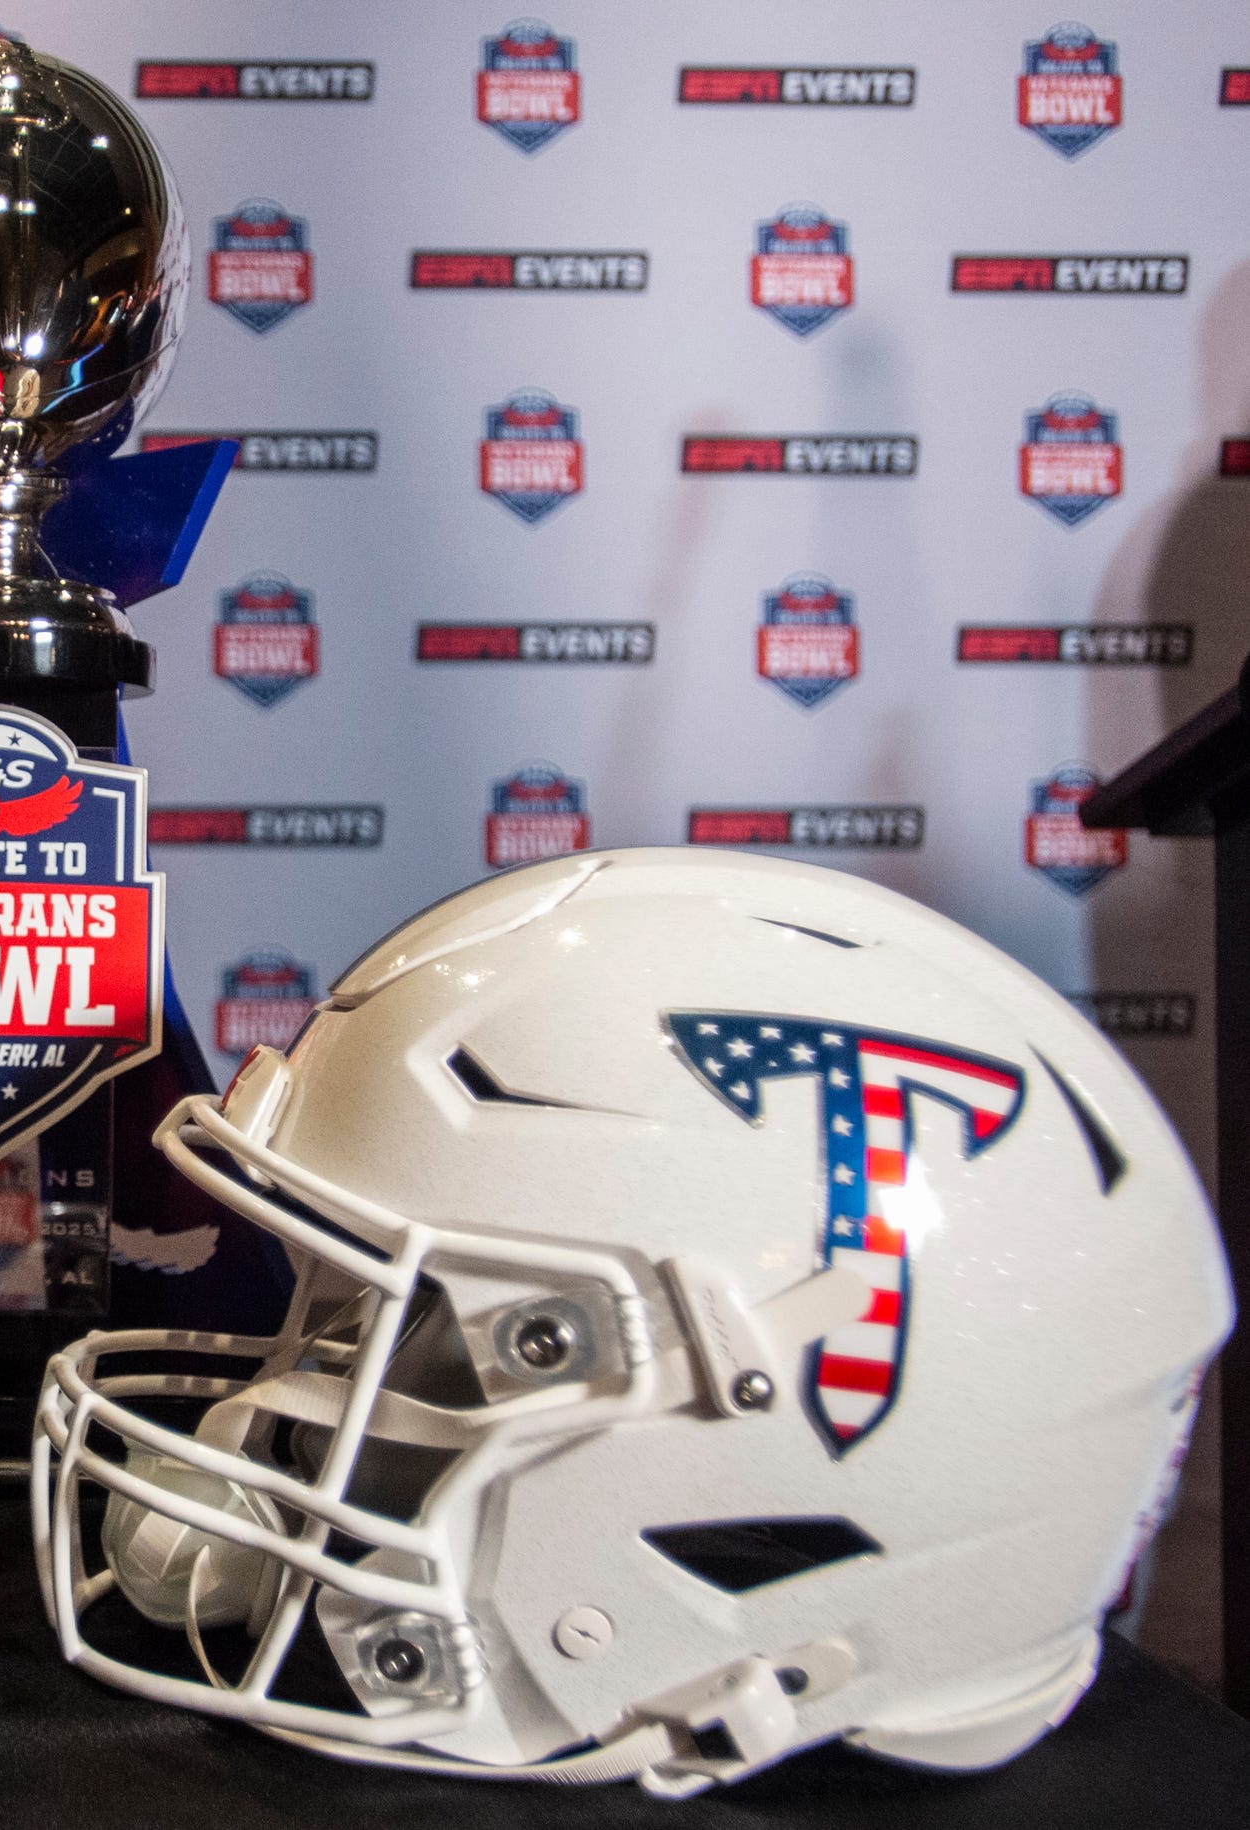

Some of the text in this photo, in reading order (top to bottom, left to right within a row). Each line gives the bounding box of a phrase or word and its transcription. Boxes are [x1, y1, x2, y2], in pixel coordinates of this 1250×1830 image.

[240, 65, 371, 97] EVENTS
[781, 69, 912, 101] EVENTS
[1029, 92, 1113, 122] BOWL
[514, 256, 646, 288] EVENTS
[1054, 259, 1185, 291] EVENTS
[244, 435, 373, 466] EVENTS
[783, 440, 915, 472] EVENTS
[520, 627, 650, 658] EVENTS
[1060, 628, 1188, 660] EVENTS
[250, 809, 380, 840] EVENTS
[790, 810, 922, 842] EVENTS
[39, 841, 87, 876] TO
[42, 1044, 66, 1068] AL
[61, 1271, 95, 1285] AL
